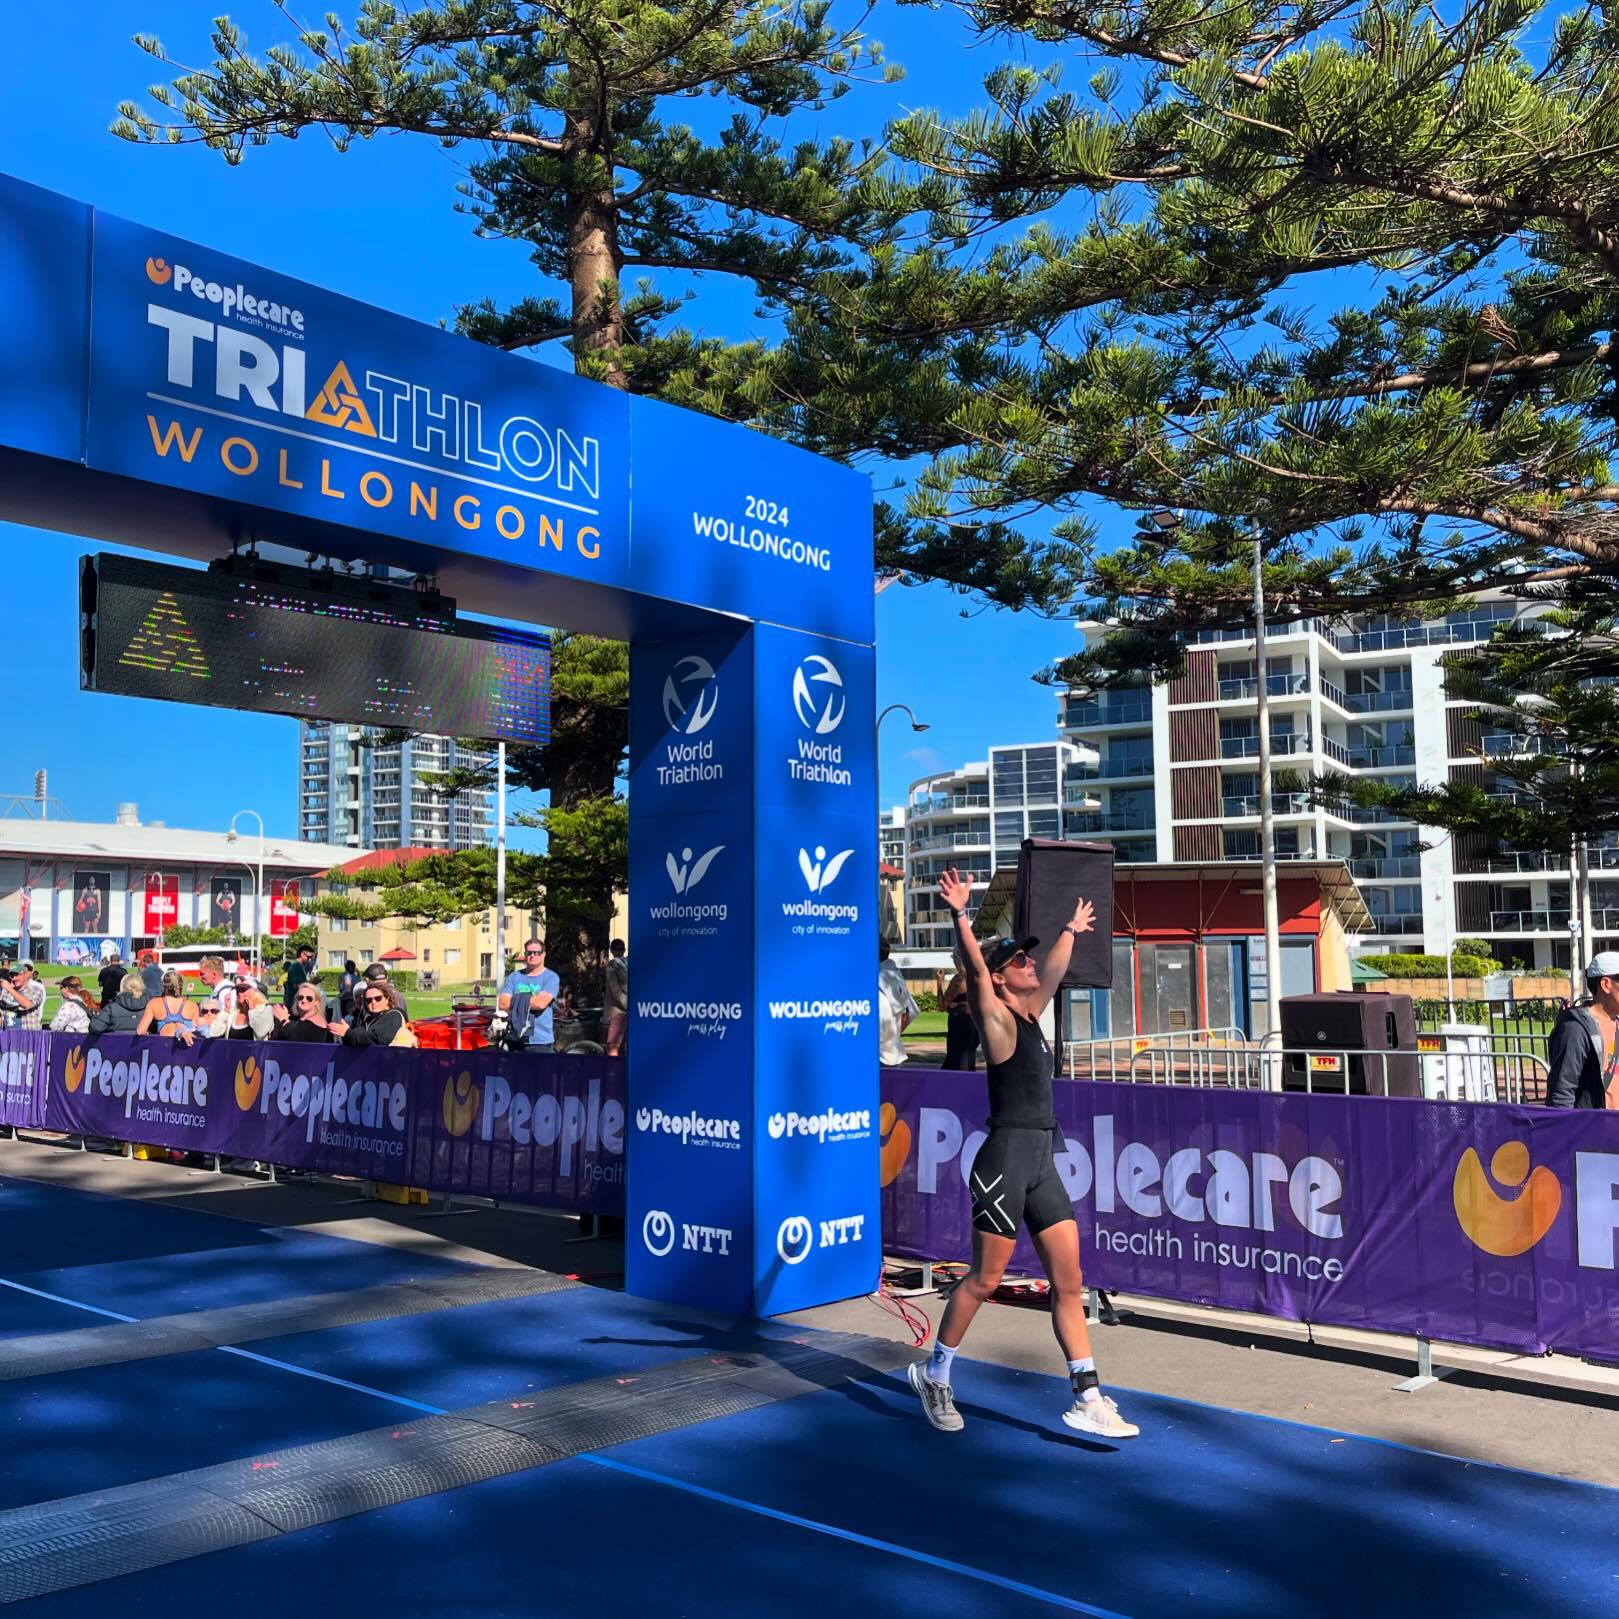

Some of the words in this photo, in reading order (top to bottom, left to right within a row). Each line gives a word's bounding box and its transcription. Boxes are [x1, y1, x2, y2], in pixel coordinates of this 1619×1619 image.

[174, 265, 304, 331] Peoplecare
[236, 312, 263, 329] health
[266, 319, 304, 340] insurance
[147, 415, 600, 560] WOLLONGONG
[745, 496, 789, 527] 2024
[694, 513, 831, 571] WOLLONGONG
[667, 739, 713, 762] World
[798, 739, 842, 763] World
[657, 761, 723, 785] Triathlon
[788, 759, 851, 785] Triathlon
[651, 903, 728, 922] wollongong
[783, 902, 858, 922] wollongong
[658, 927, 669, 936] city
[671, 926, 679, 935] of
[681, 926, 717, 935] innovation
[792, 926, 803, 935] city
[805, 925, 814, 934] of
[815, 925, 850, 935] innovation
[637, 1002, 742, 1020] WOLLONGONG
[769, 1000, 871, 1019] WOLLONGONG
[1420, 1039, 1440, 1047] TFH
[1316, 1057, 1336, 1065] TFH
[84, 1046, 207, 1118] Peoplecare
[260, 1059, 405, 1143] Peoplecare
[136, 1103, 163, 1122] health
[164, 1110, 206, 1129] insurance
[652, 1109, 741, 1144] Peoplecare
[787, 1107, 870, 1144] Peoplecare
[320, 1126, 352, 1151] health
[353, 1134, 404, 1158] insurance
[691, 1138, 710, 1147] health
[711, 1140, 741, 1150] insurance
[828, 1133, 847, 1142] health
[847, 1130, 871, 1140] insurance
[584, 1159, 625, 1184] healt
[917, 1107, 1344, 1240] Plecare
[683, 1223, 732, 1255] NTT
[819, 1214, 864, 1248] NTT
[1096, 1221, 1184, 1260] health
[1194, 1231, 1345, 1283] insurance
